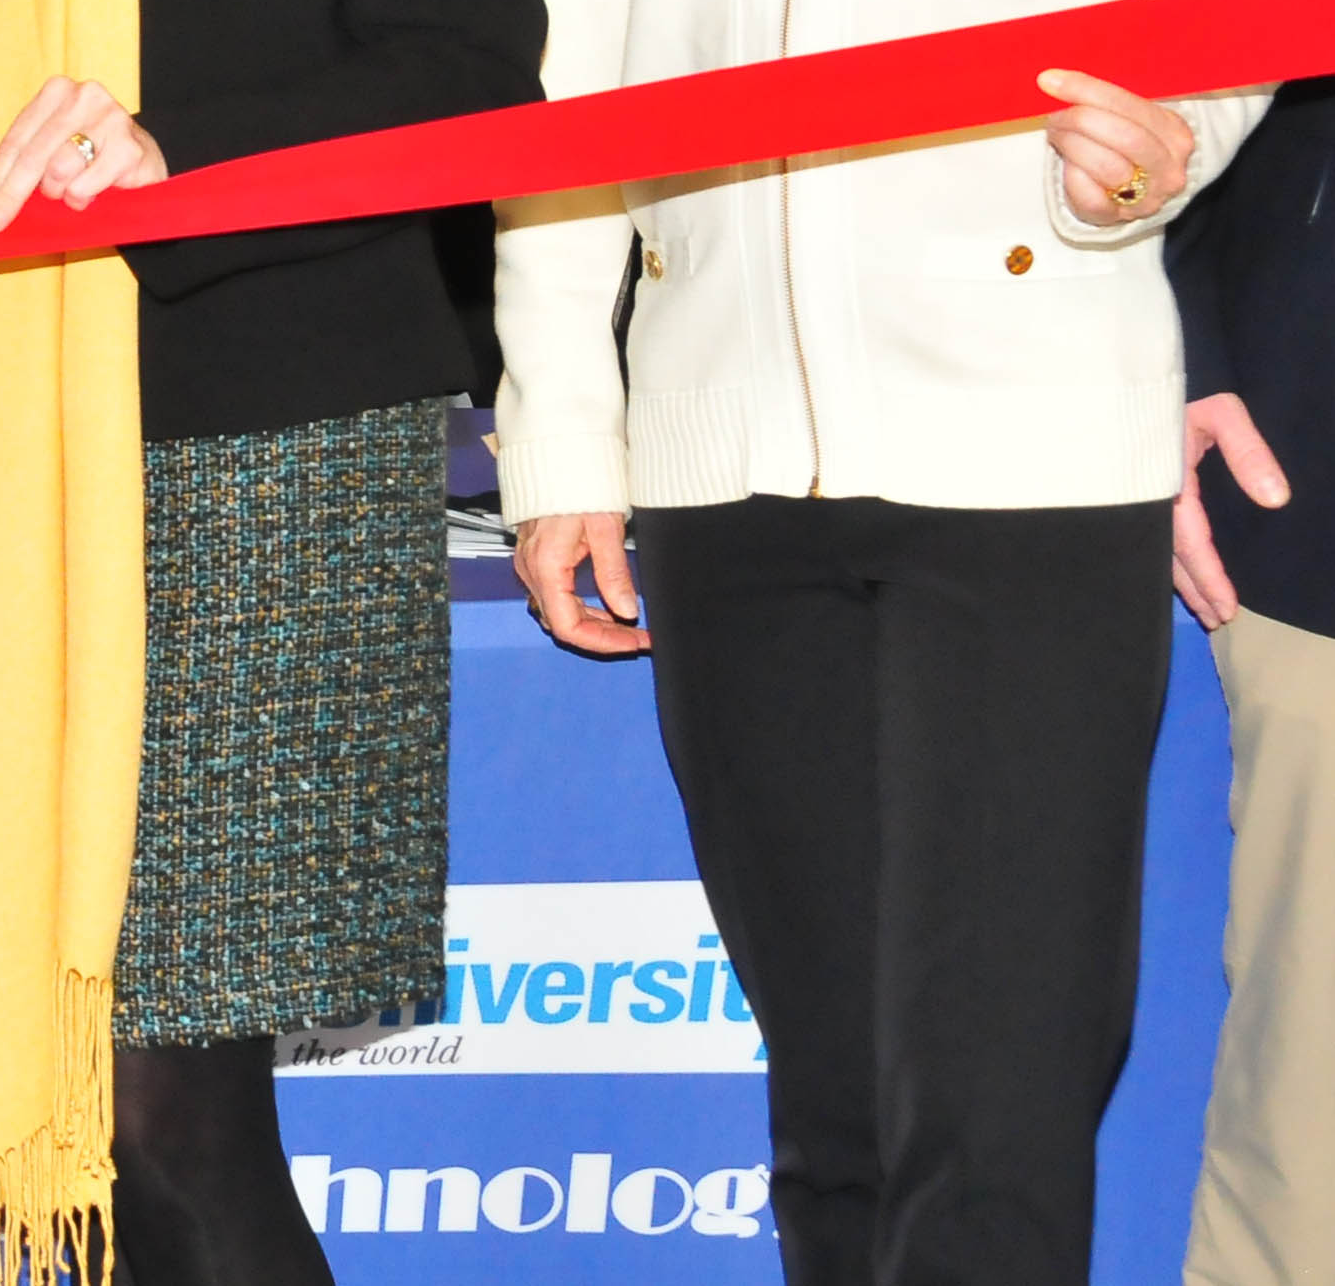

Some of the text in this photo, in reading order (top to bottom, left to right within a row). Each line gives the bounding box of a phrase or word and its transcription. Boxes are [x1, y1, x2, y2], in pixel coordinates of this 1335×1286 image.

[321, 934, 770, 1062] iversit
[291, 1035, 464, 1067] the world
[290, 1152, 780, 1239] hnolog
